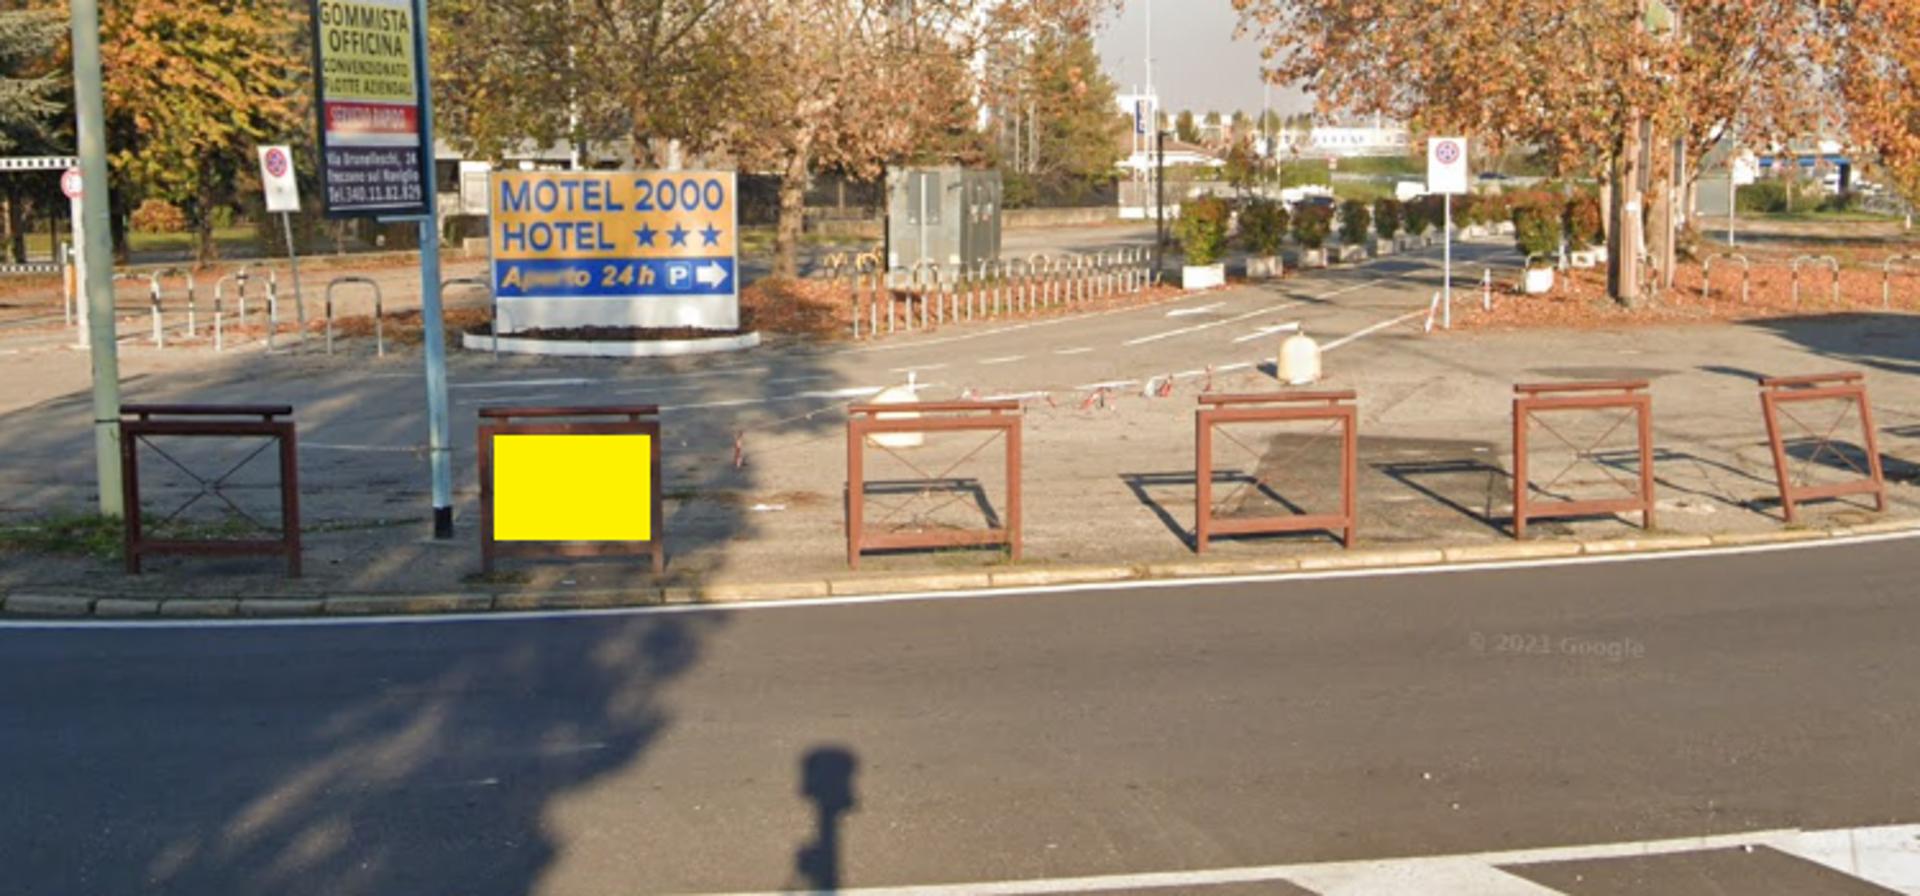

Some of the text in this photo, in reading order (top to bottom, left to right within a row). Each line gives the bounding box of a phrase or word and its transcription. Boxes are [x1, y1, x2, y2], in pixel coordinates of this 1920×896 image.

[320, 2, 409, 33] GOMMISTA
[329, 29, 404, 58] OFFICINA
[327, 151, 341, 166] Via
[501, 178, 724, 212] MOTEL 2000
[502, 222, 615, 251] HOTEL
